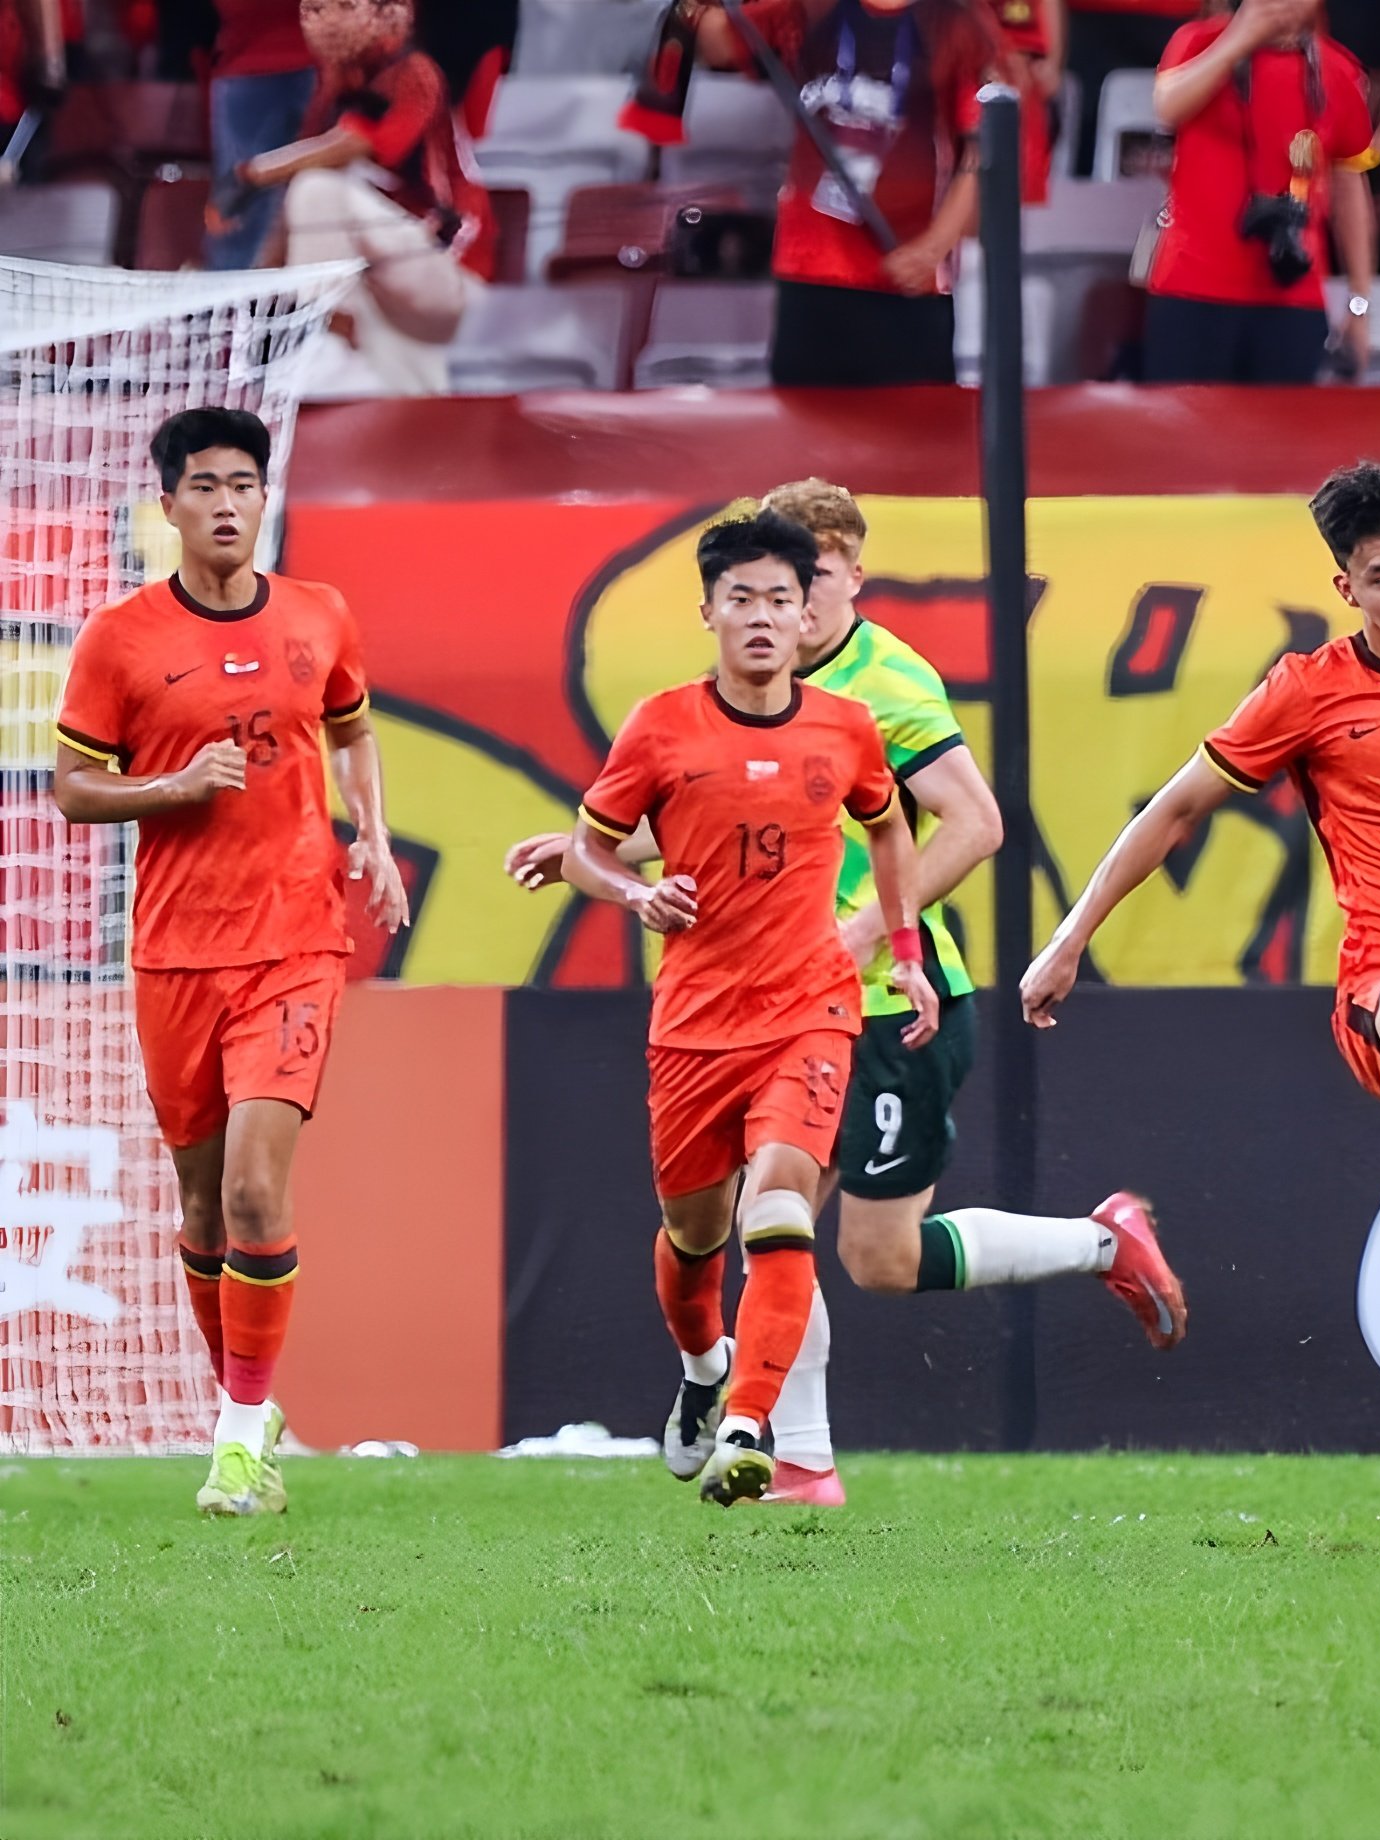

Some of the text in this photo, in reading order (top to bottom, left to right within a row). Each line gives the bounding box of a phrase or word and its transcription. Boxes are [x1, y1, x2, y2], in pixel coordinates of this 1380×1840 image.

[735, 822, 786, 881] 19
[275, 999, 319, 1059] 15
[875, 1092, 902, 1155] 9
